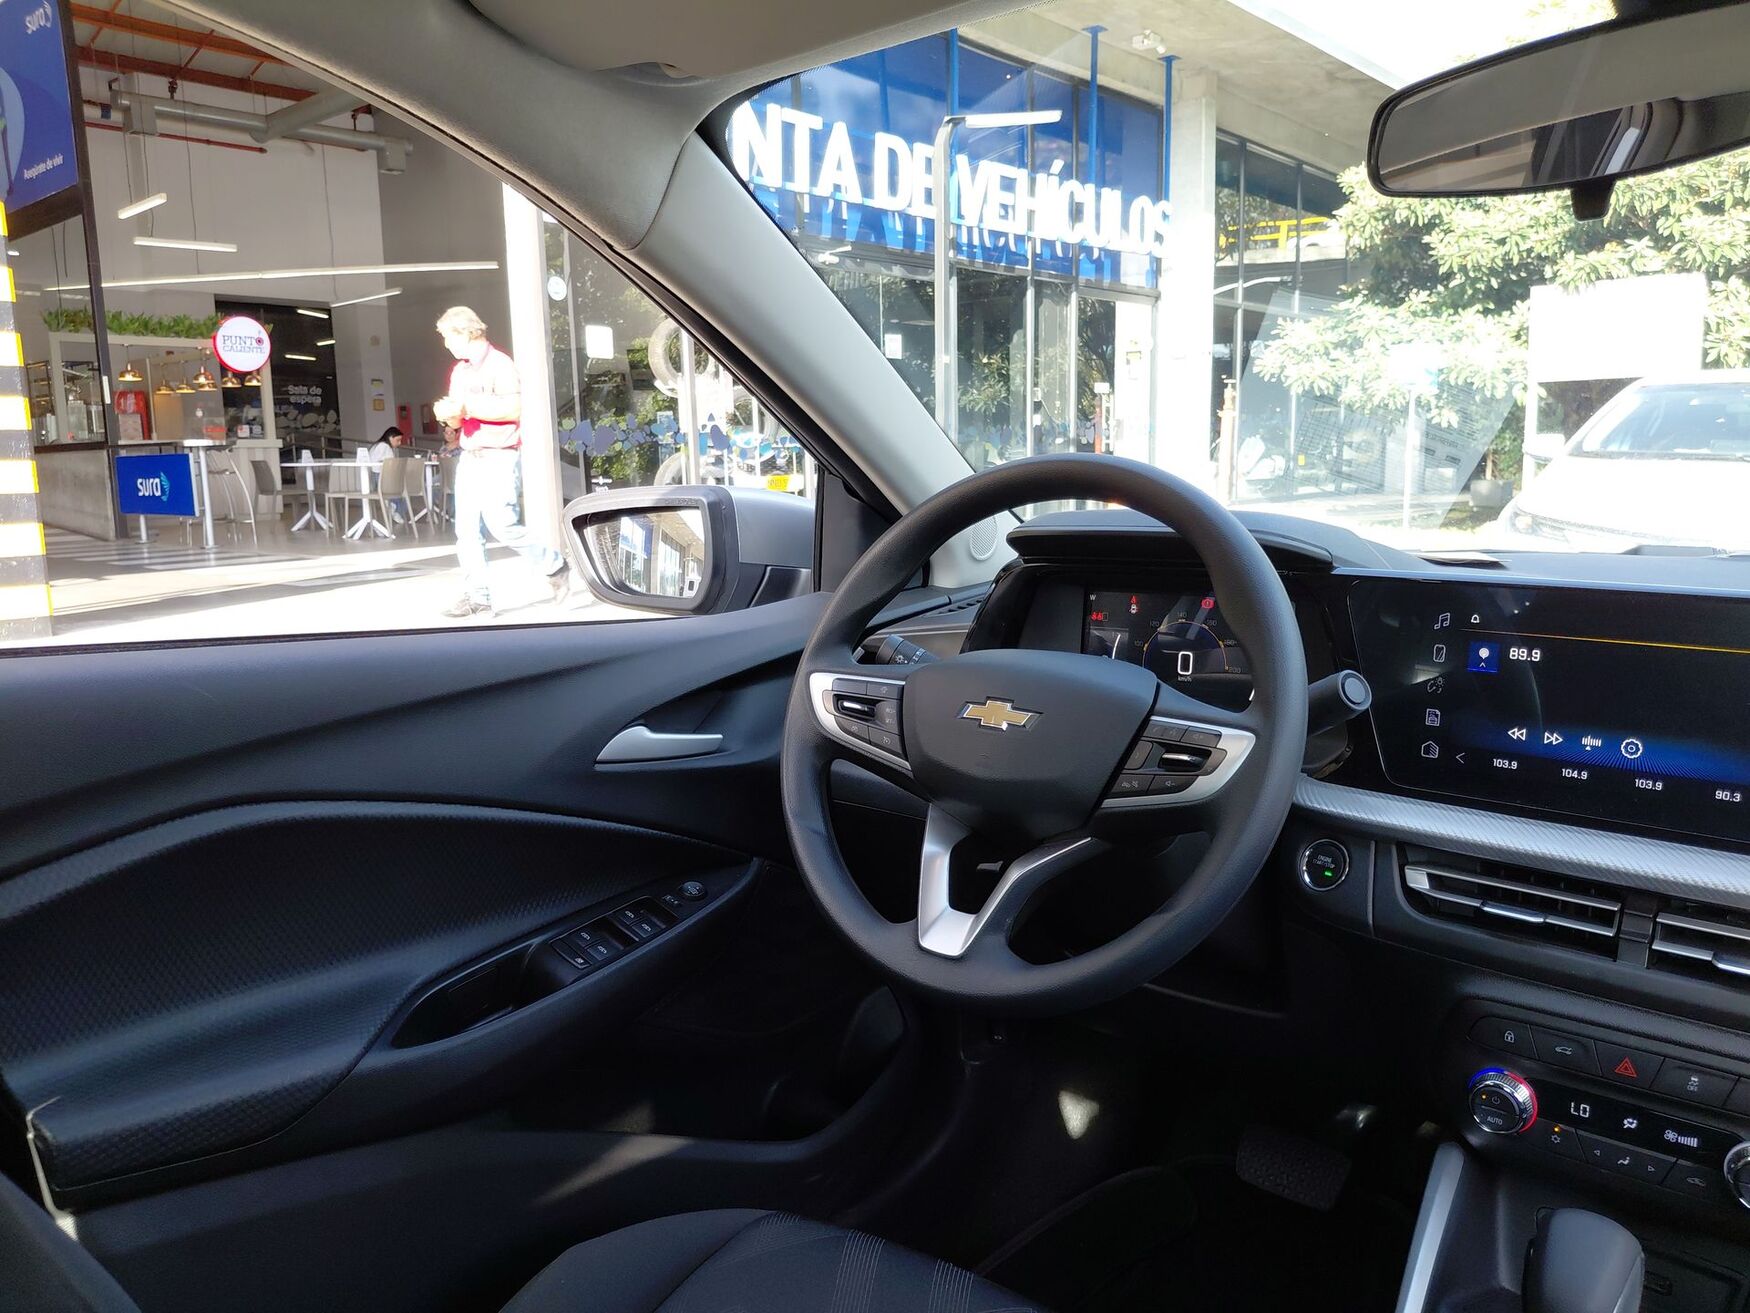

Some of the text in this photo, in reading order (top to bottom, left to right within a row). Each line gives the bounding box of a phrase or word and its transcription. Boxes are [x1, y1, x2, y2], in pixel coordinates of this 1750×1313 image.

[874, 131, 936, 219] DE
[222, 335, 264, 346] PUNTO
[309, 386, 322, 395] de
[137, 478, 161, 497] sura
[1509, 647, 1541, 662] 89.9
[1177, 651, 1193, 675] 0
[1492, 758, 1518, 770] 103.9
[1561, 768, 1588, 780] 104.9
[1635, 778, 1663, 791] 103.9
[1715, 790, 1741, 802] 90.3
[1486, 1116, 1503, 1126] AUTO
